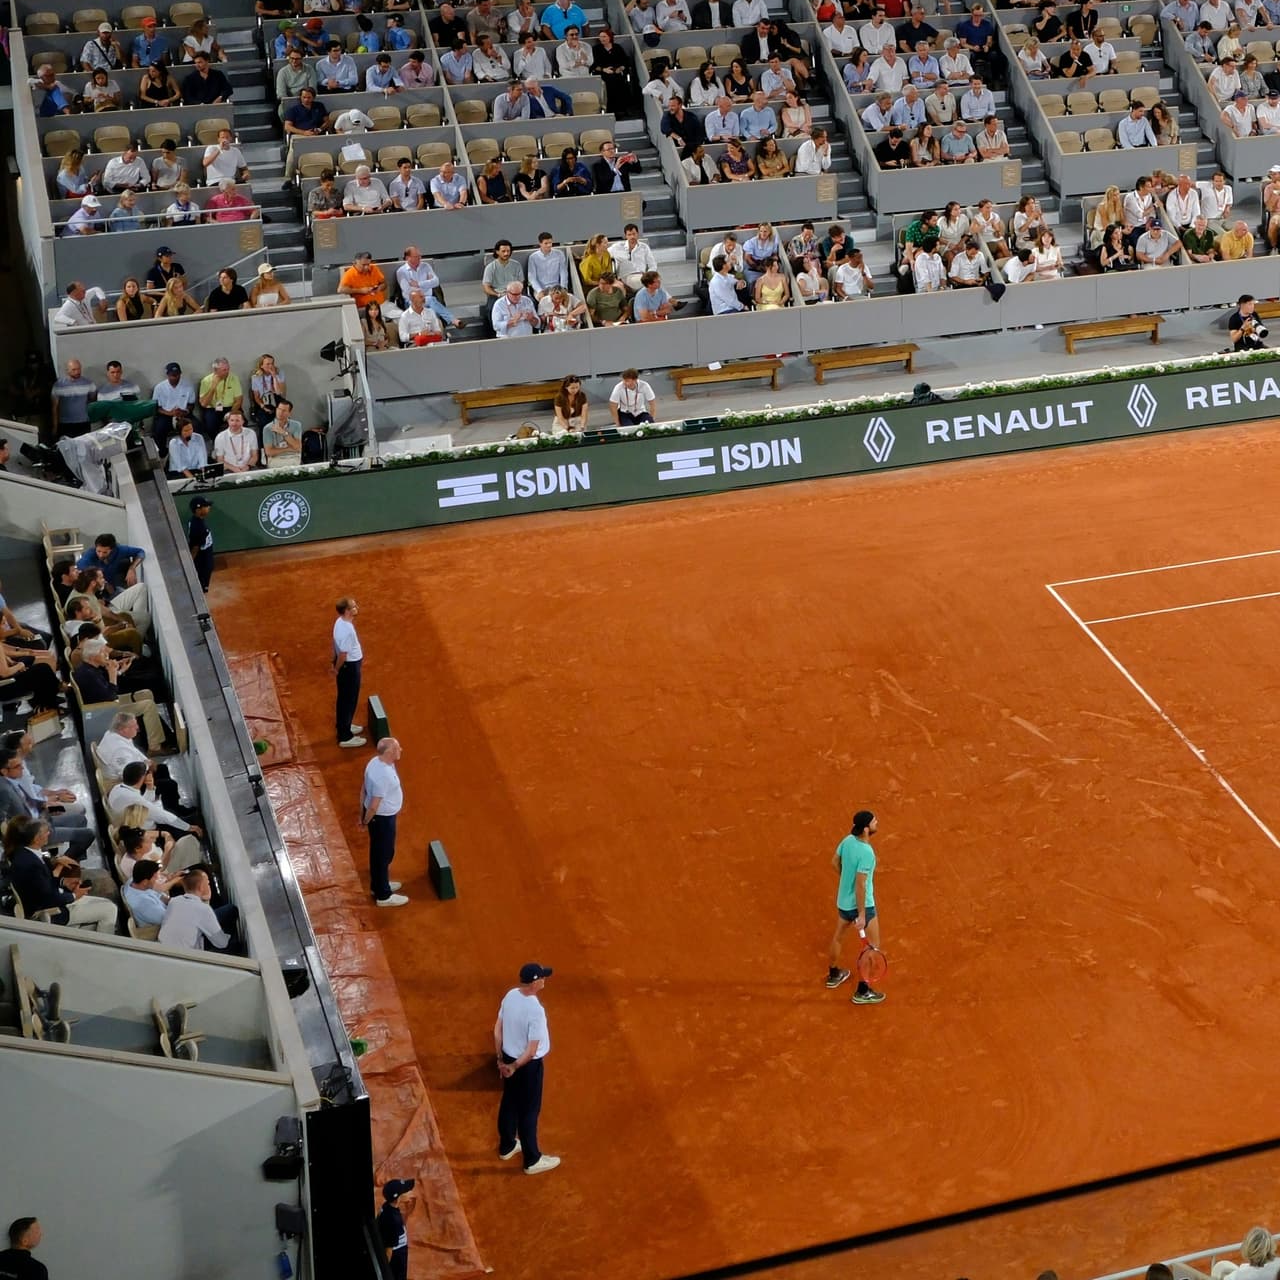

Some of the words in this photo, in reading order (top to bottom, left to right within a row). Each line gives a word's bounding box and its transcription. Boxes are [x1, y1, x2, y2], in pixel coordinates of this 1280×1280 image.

[926, 400, 1094, 445] RENAULT
[721, 437, 803, 473] ISDIN
[505, 462, 591, 499] ISDIN
